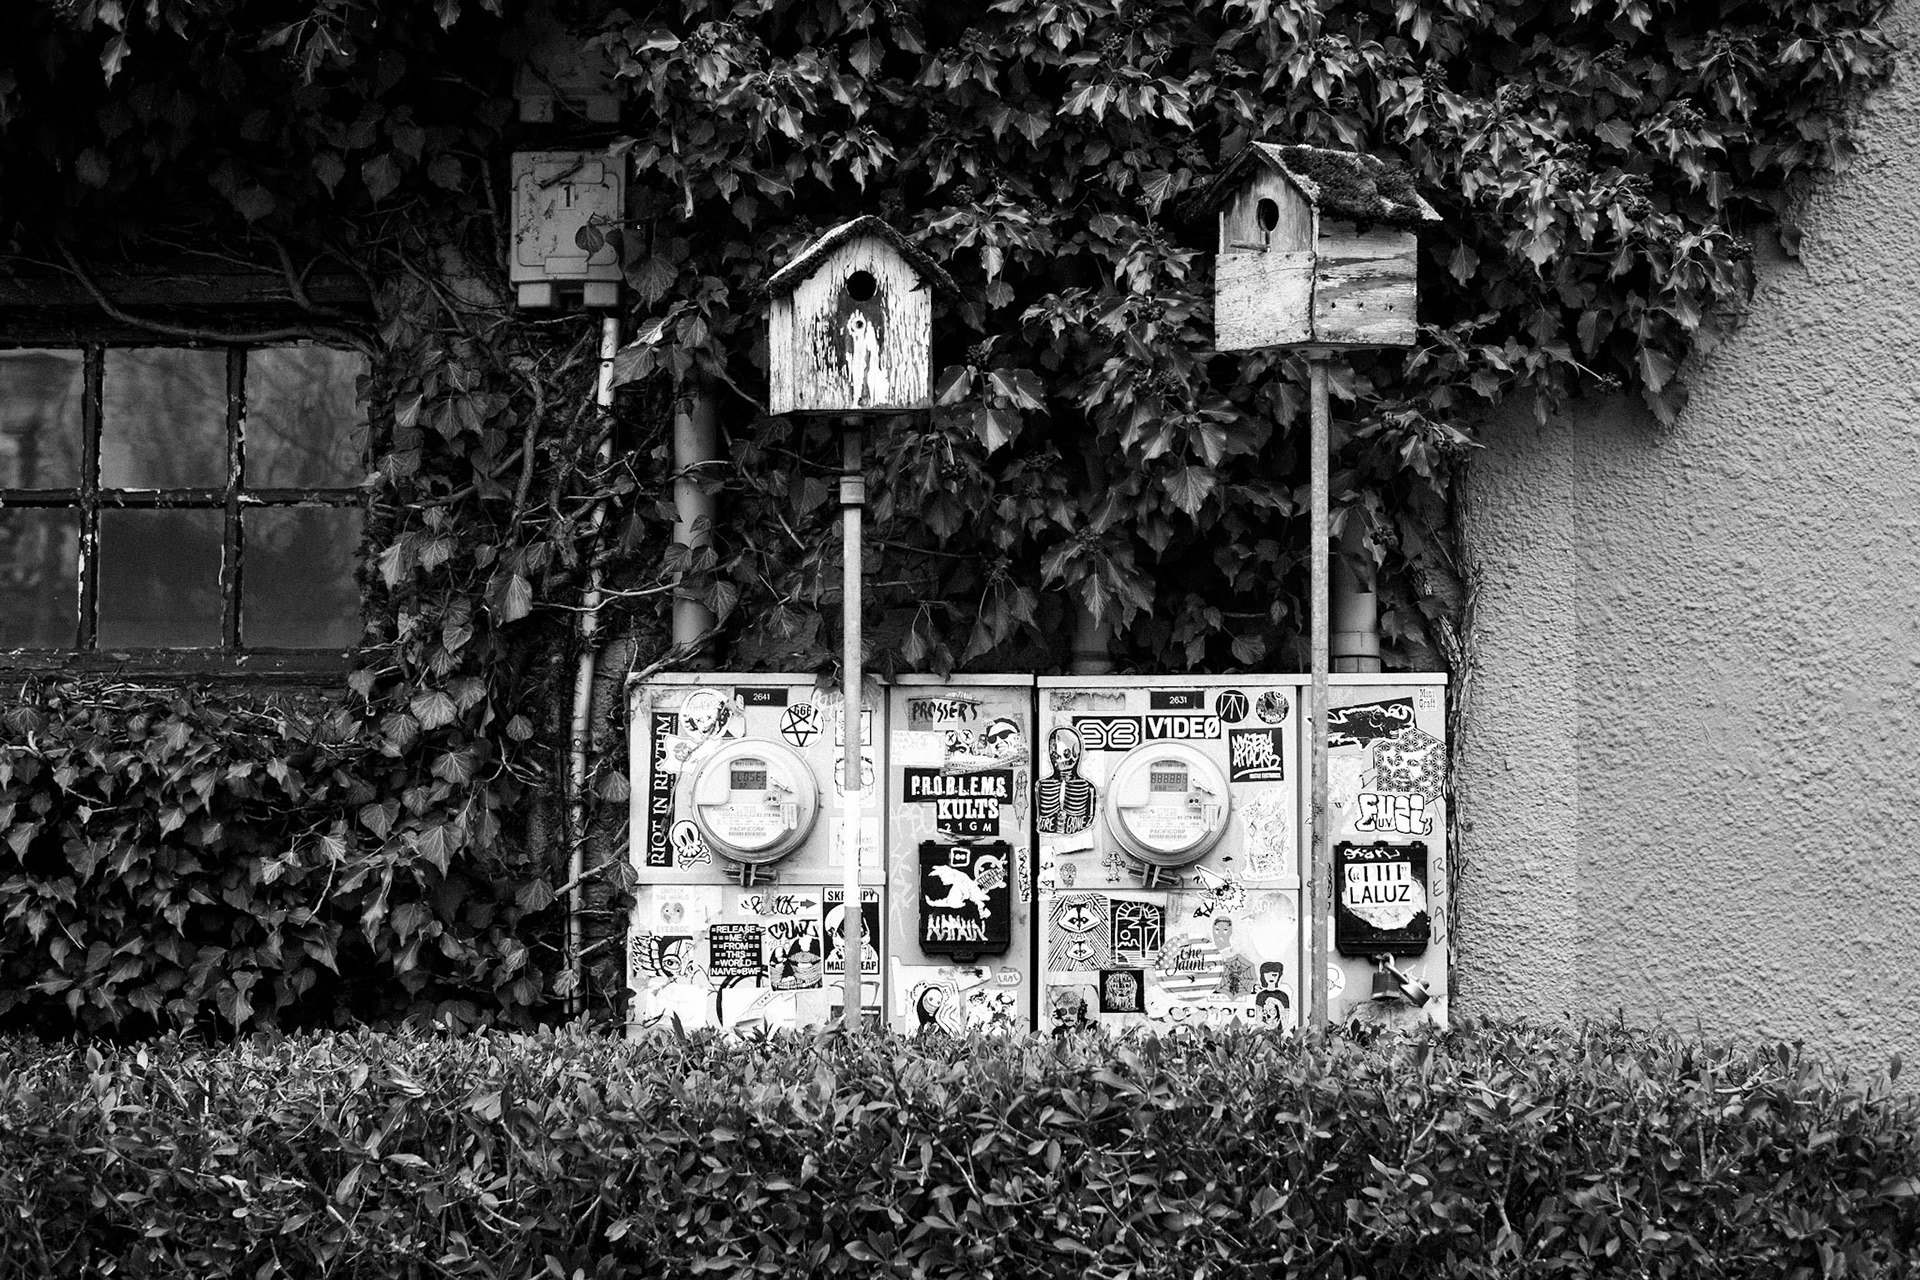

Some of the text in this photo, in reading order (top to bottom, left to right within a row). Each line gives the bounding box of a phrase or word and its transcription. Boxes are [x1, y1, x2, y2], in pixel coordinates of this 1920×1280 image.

[563, 184, 571, 208] 1
[753, 693, 770, 701] 2641
[1169, 696, 1188, 704] 2631
[794, 705, 812, 716] 666
[653, 796, 669, 814] IN
[937, 799, 999, 819] KULTS
[652, 820, 667, 865] RIOT
[1350, 885, 1411, 904] LALUZ
[716, 925, 756, 934] RELEASE
[724, 942, 749, 950] FROM
[726, 950, 746, 958] THIS
[1180, 944, 1202, 960] The
[720, 959, 752, 967] WORLD
